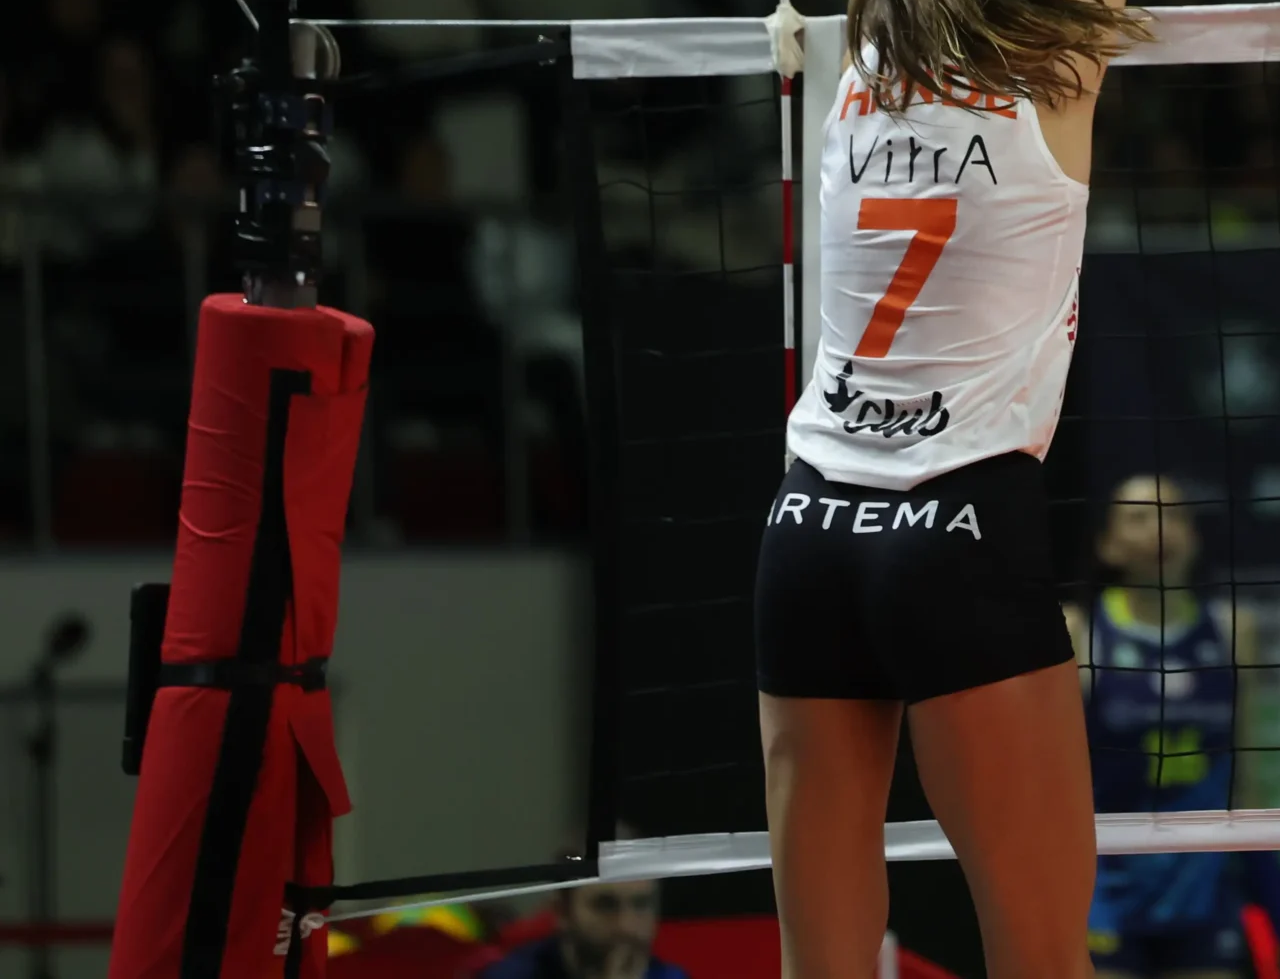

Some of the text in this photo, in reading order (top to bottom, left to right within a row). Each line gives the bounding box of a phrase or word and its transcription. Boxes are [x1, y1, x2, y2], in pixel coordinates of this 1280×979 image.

[849, 133, 998, 186] VitrA
[853, 197, 958, 359] 7
[843, 390, 950, 438] Club
[766, 492, 982, 541] RTEMA
